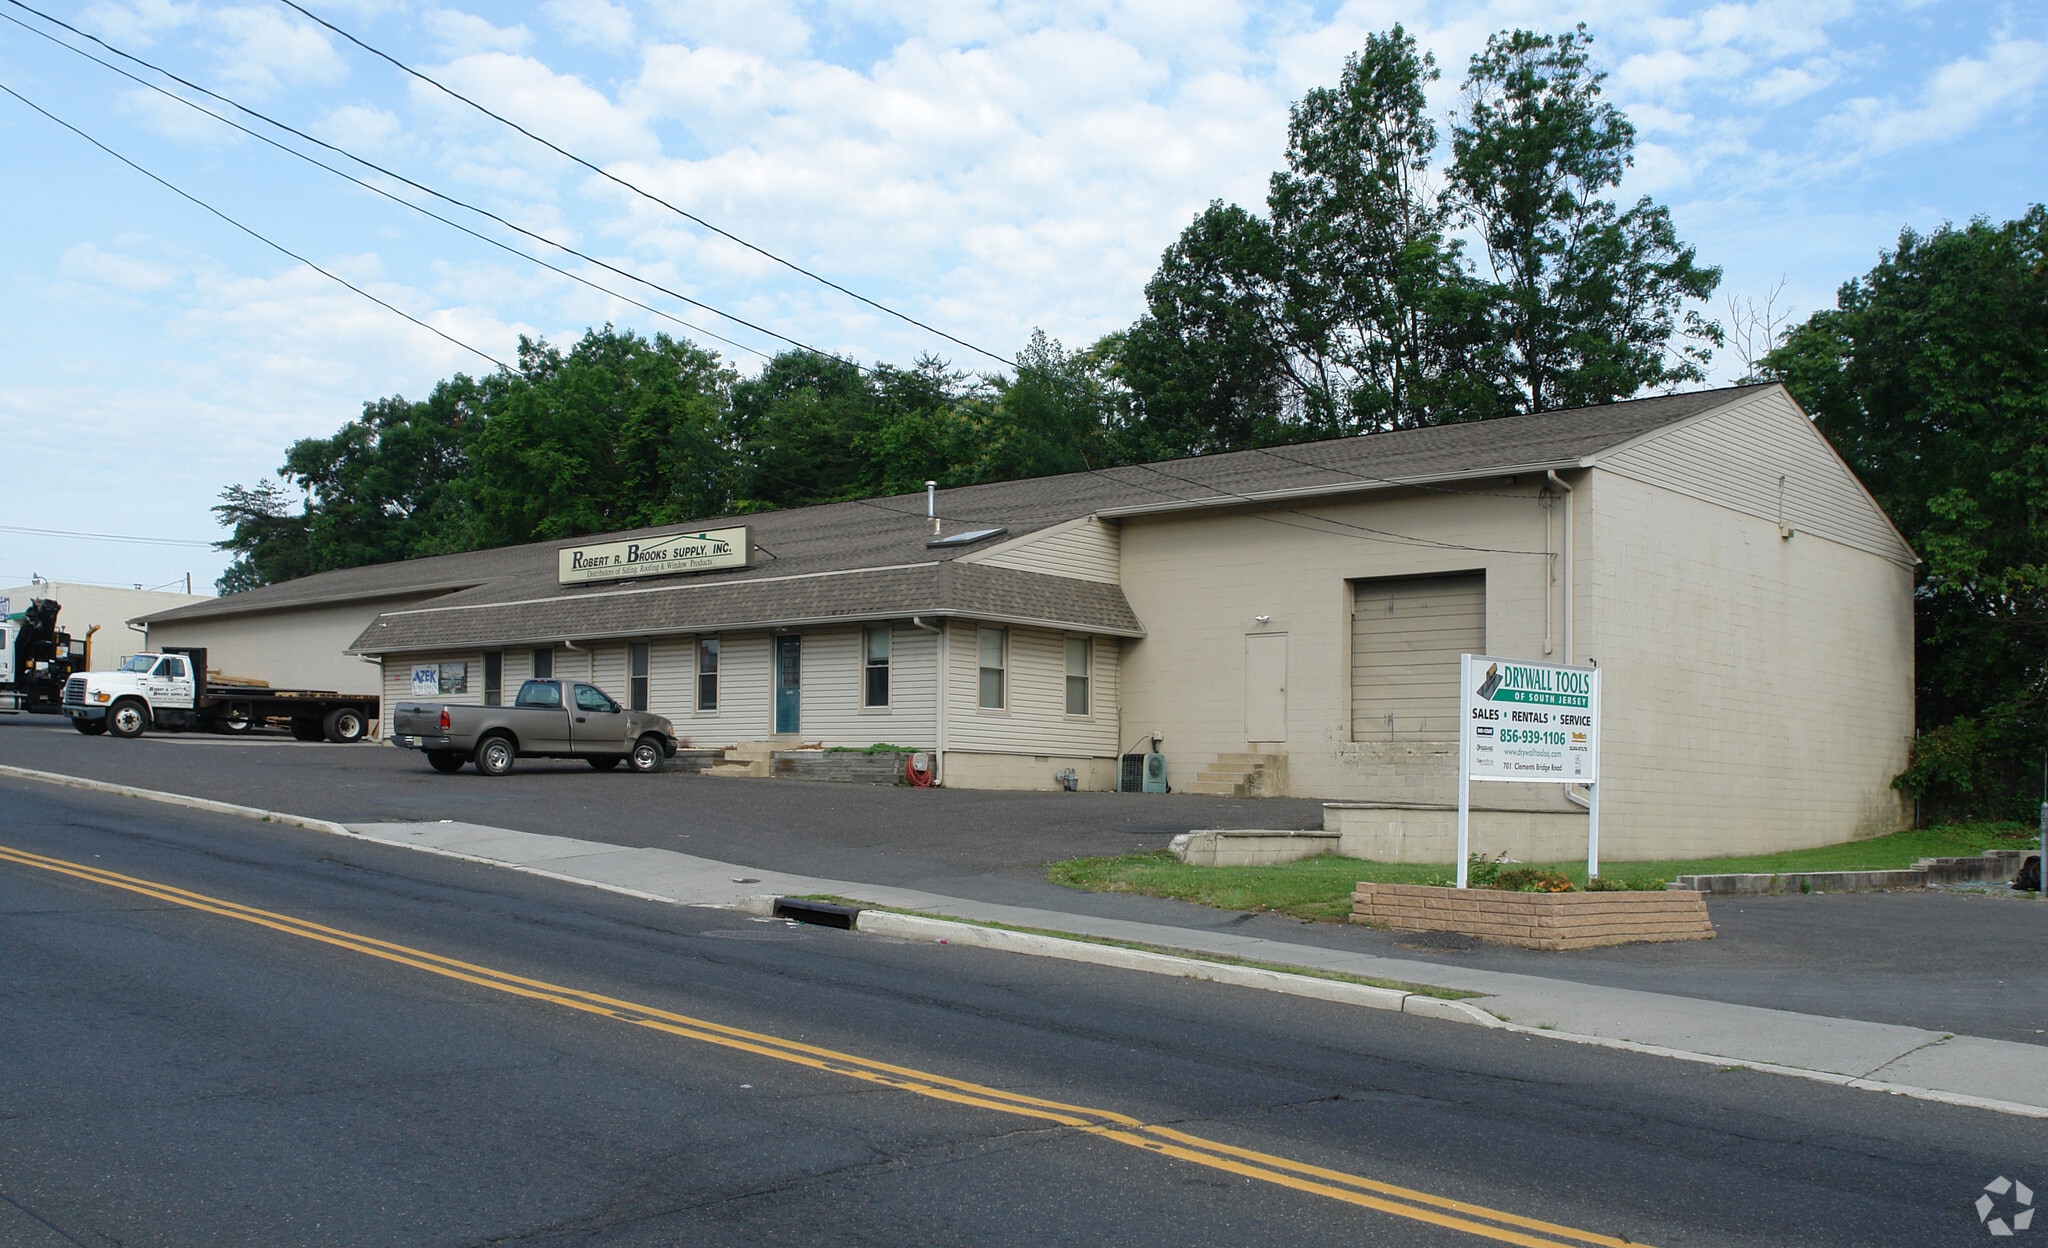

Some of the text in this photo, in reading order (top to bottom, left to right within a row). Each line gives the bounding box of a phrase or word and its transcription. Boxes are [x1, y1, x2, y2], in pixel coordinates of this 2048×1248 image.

[572, 542, 732, 569] ROBERT R. BROOKS SUPPLY, INC.
[615, 568, 621, 576] of
[667, 561, 687, 569] Window
[690, 559, 712, 567] Products
[412, 669, 437, 684] AZEK
[1504, 665, 1589, 694] DRYWALL TOOLS
[1514, 691, 1587, 706] OF SOUTH JERSEY
[1472, 708, 1591, 727] SALES RENTALS SERVICE
[1499, 728, 1566, 745] 856-939-1106
[1503, 762, 1512, 770] 701
[1514, 762, 1535, 771] Clements
[1536, 763, 1550, 773] Bridge
[1551, 763, 1562, 771] Road
